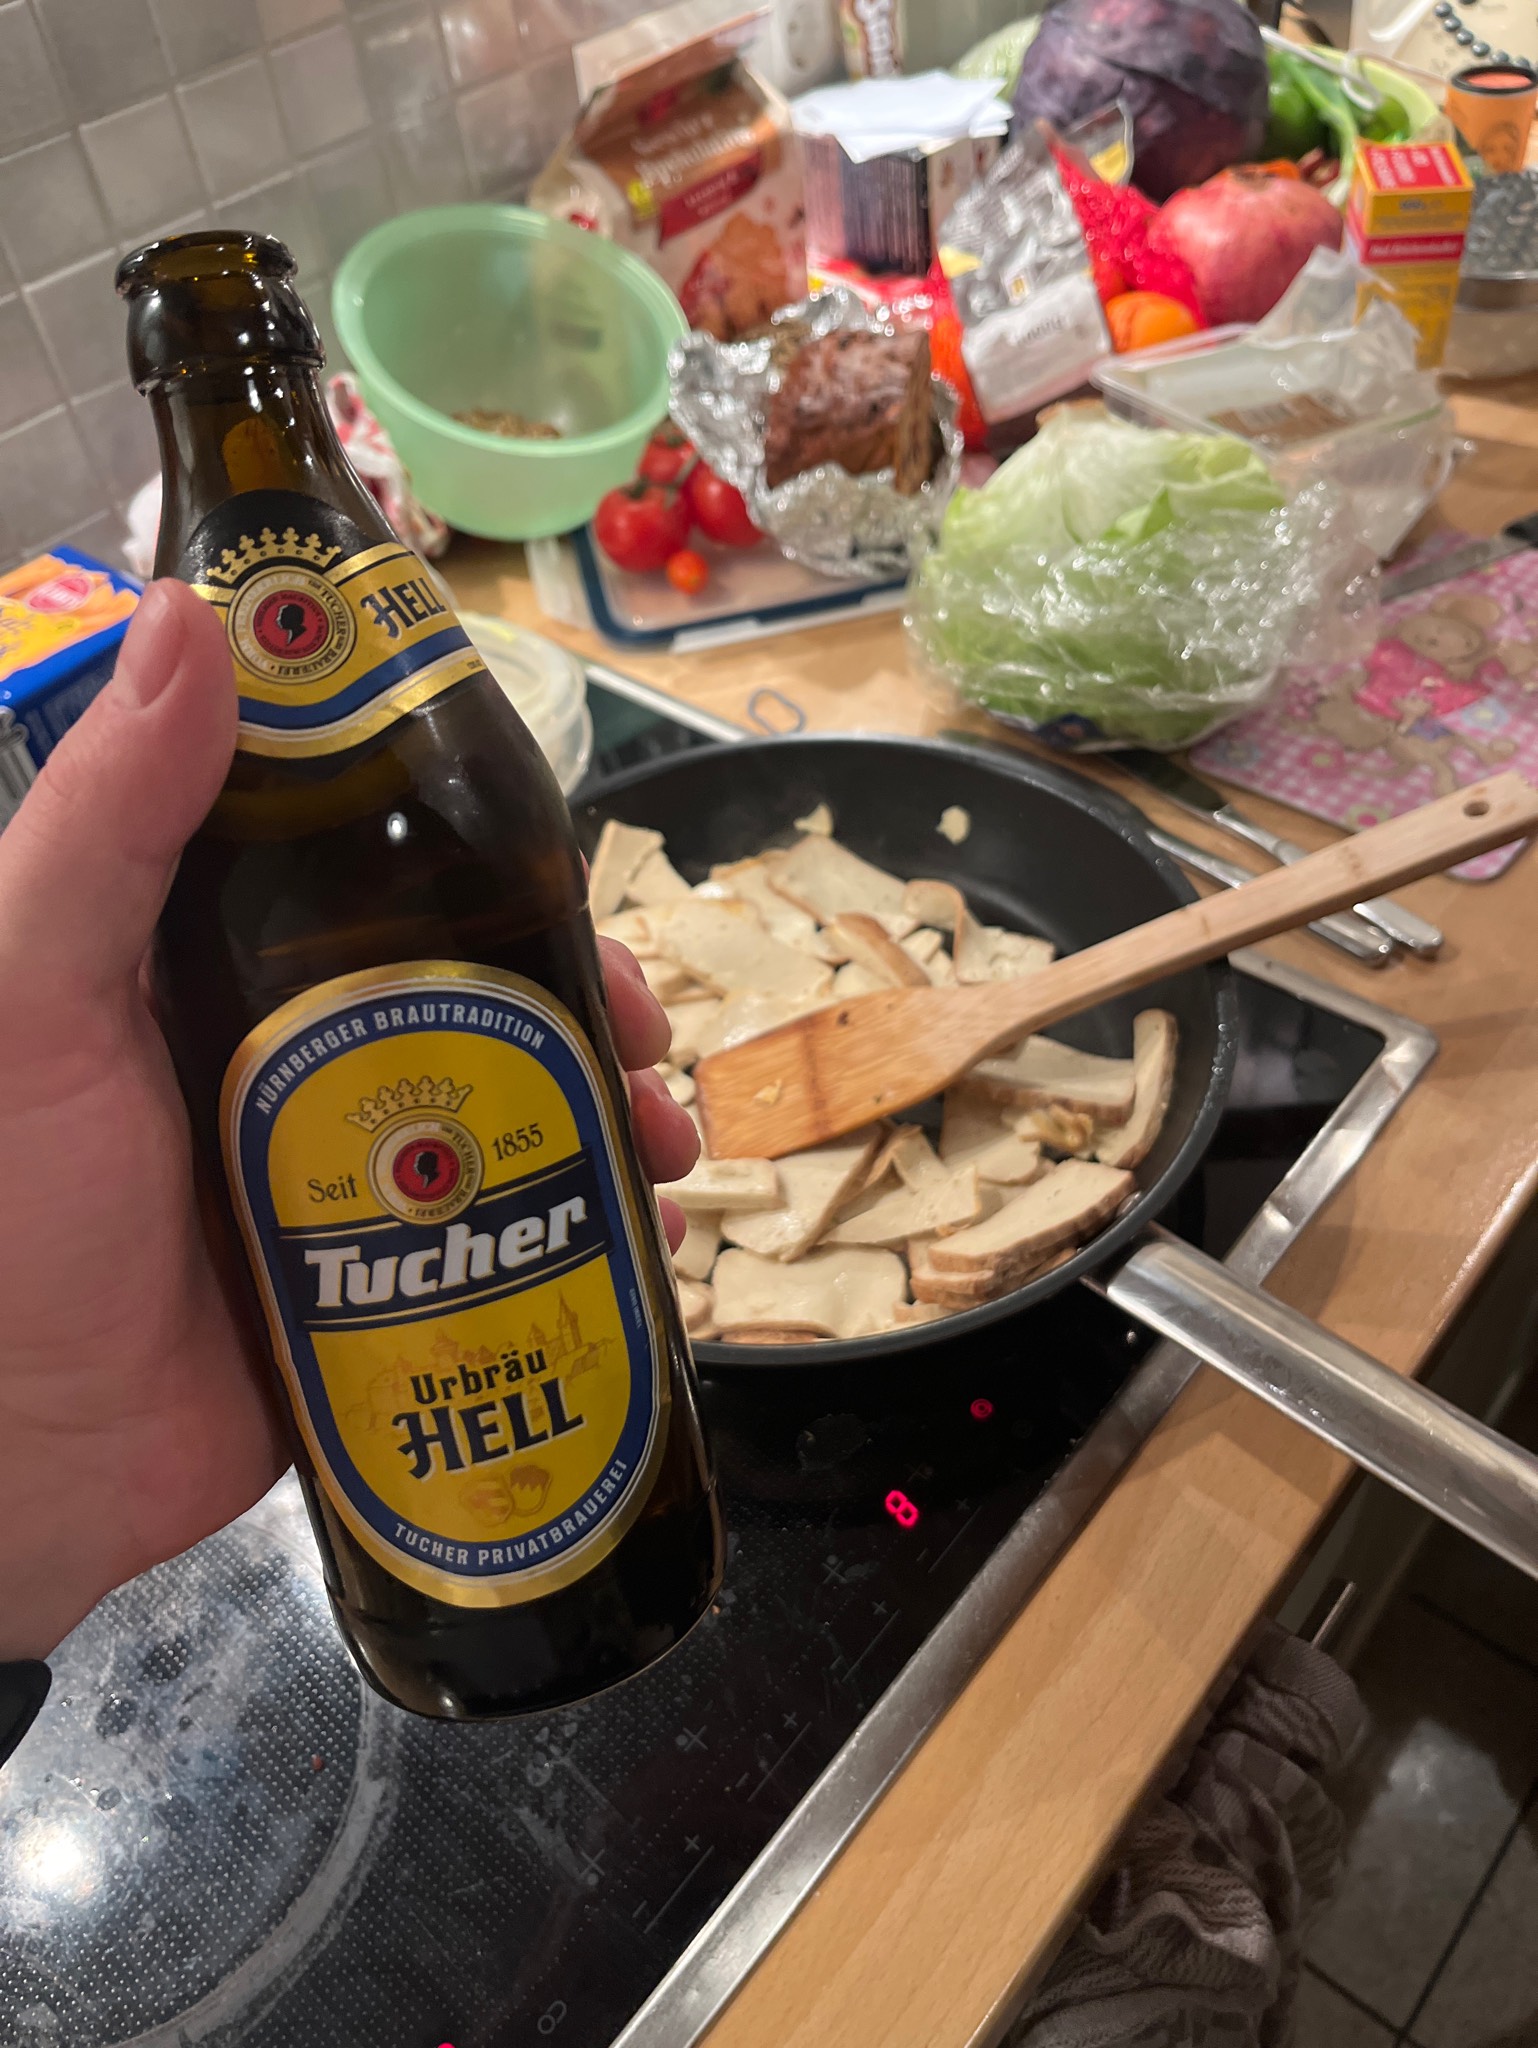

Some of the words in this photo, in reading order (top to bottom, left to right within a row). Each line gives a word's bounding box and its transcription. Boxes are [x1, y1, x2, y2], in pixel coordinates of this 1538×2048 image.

[360, 577, 448, 640] HELL
[255, 1018, 368, 1115] NÜRNBERGER
[373, 1003, 546, 1050] BRAUTRADITION
[307, 1174, 358, 1203] Seit
[491, 1123, 544, 1161] 1855
[304, 1196, 588, 1307] Tucher
[391, 1377, 586, 1482] HELL
[410, 1349, 547, 1405] Urbräu
[395, 1522, 468, 1566] TUCHER
[478, 1459, 627, 1566] PRIVATBRAUEREI
